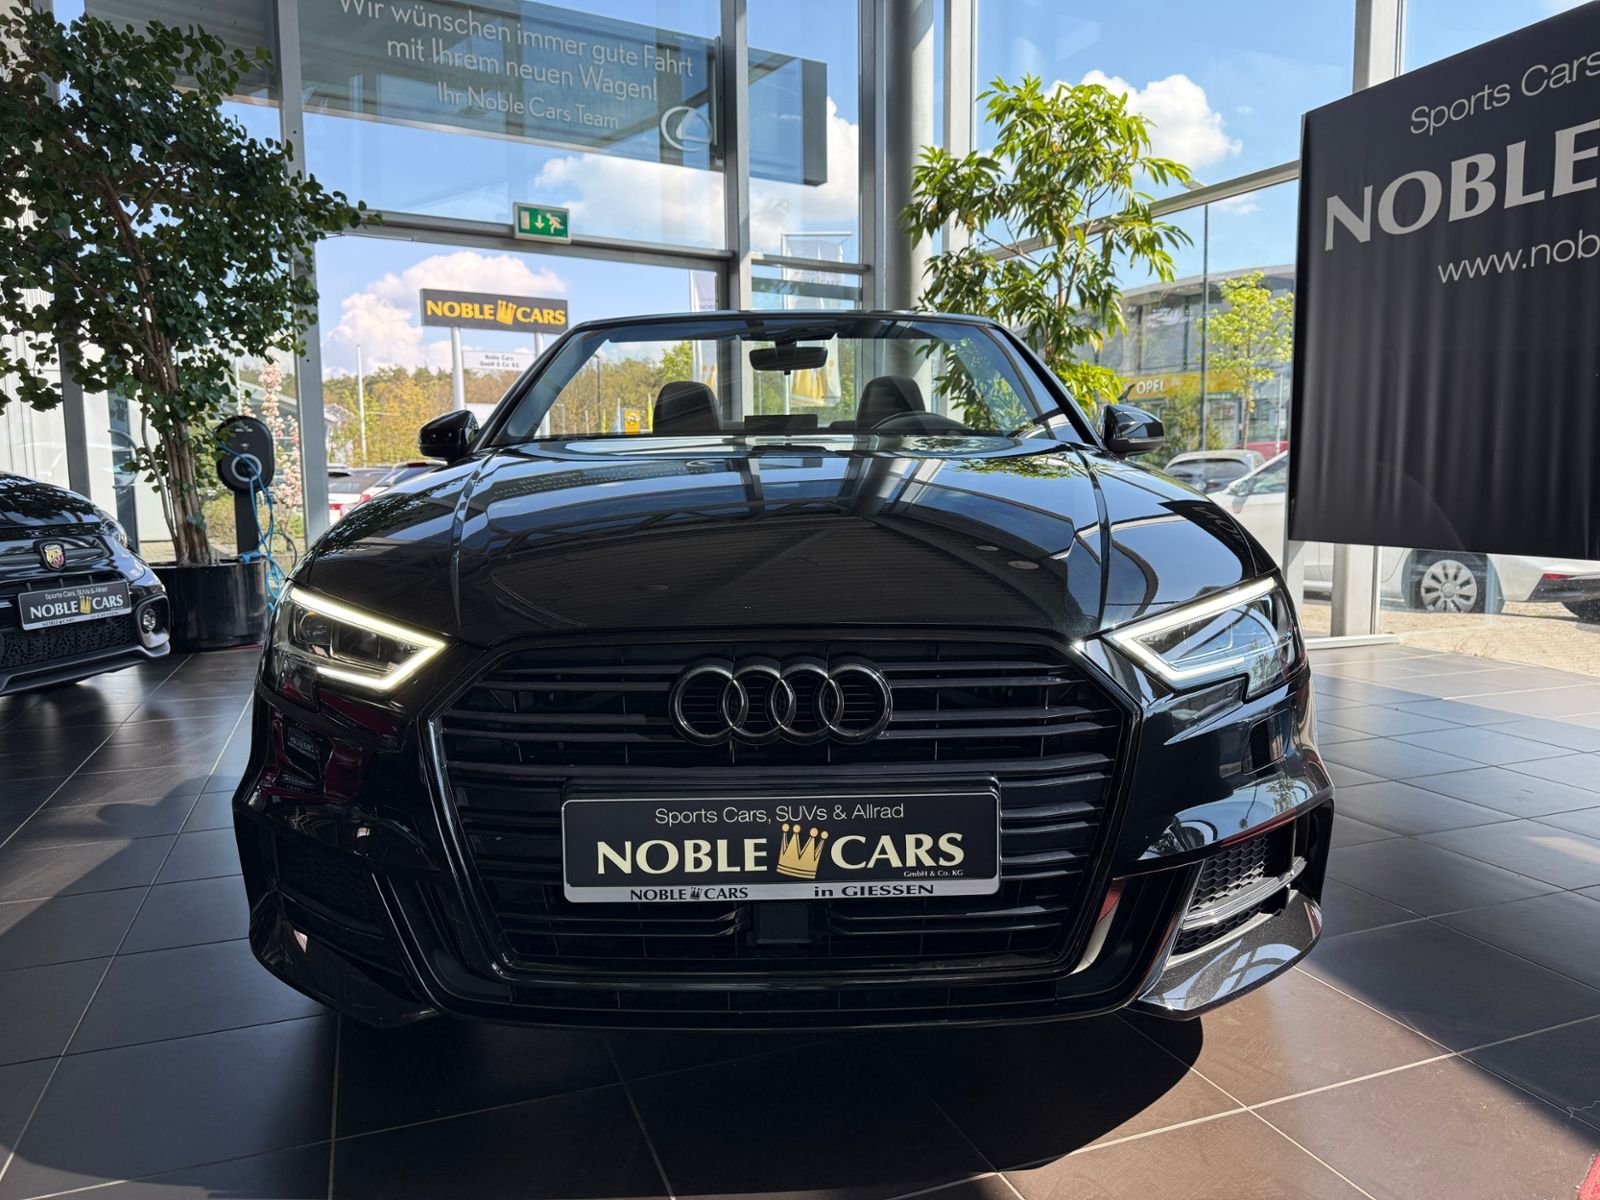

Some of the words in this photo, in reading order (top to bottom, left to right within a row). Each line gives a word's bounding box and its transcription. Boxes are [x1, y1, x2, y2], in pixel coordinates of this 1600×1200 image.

[341, 0, 384, 19] Wir
[391, 3, 510, 43] wünschen
[516, 23, 586, 57] immer
[591, 40, 638, 67] gute
[643, 45, 693, 77] Fahrt
[387, 38, 424, 63] mit
[432, 38, 499, 74] Ihrem
[505, 60, 573, 88] neuen
[579, 66, 658, 102] Wagen!
[437, 80, 463, 105] Ihr
[467, 87, 525, 116] Noble
[529, 99, 571, 123] Cars
[575, 103, 619, 130] Team
[1410, 83, 1511, 136] Sports
[1521, 51, 1600, 97] Cars
[1325, 119, 1600, 252] NOBLE
[426, 300, 495, 320] NOBLE
[516, 307, 566, 325] CARS
[1136, 379, 1166, 394] OPEL
[30, 600, 78, 619] NOBLE
[92, 595, 123, 610] CARS
[655, 805, 718, 827] Sports
[723, 805, 772, 825] Cars,
[776, 804, 828, 822] SUVs
[833, 805, 847, 820] &
[852, 803, 905, 820] Allrad
[596, 837, 768, 875] NOBLE
[831, 832, 965, 869] CARS
[630, 887, 686, 901] NOBLE
[704, 886, 749, 901] CARS
[813, 885, 834, 898] in
[841, 884, 934, 896] GIESSEN
